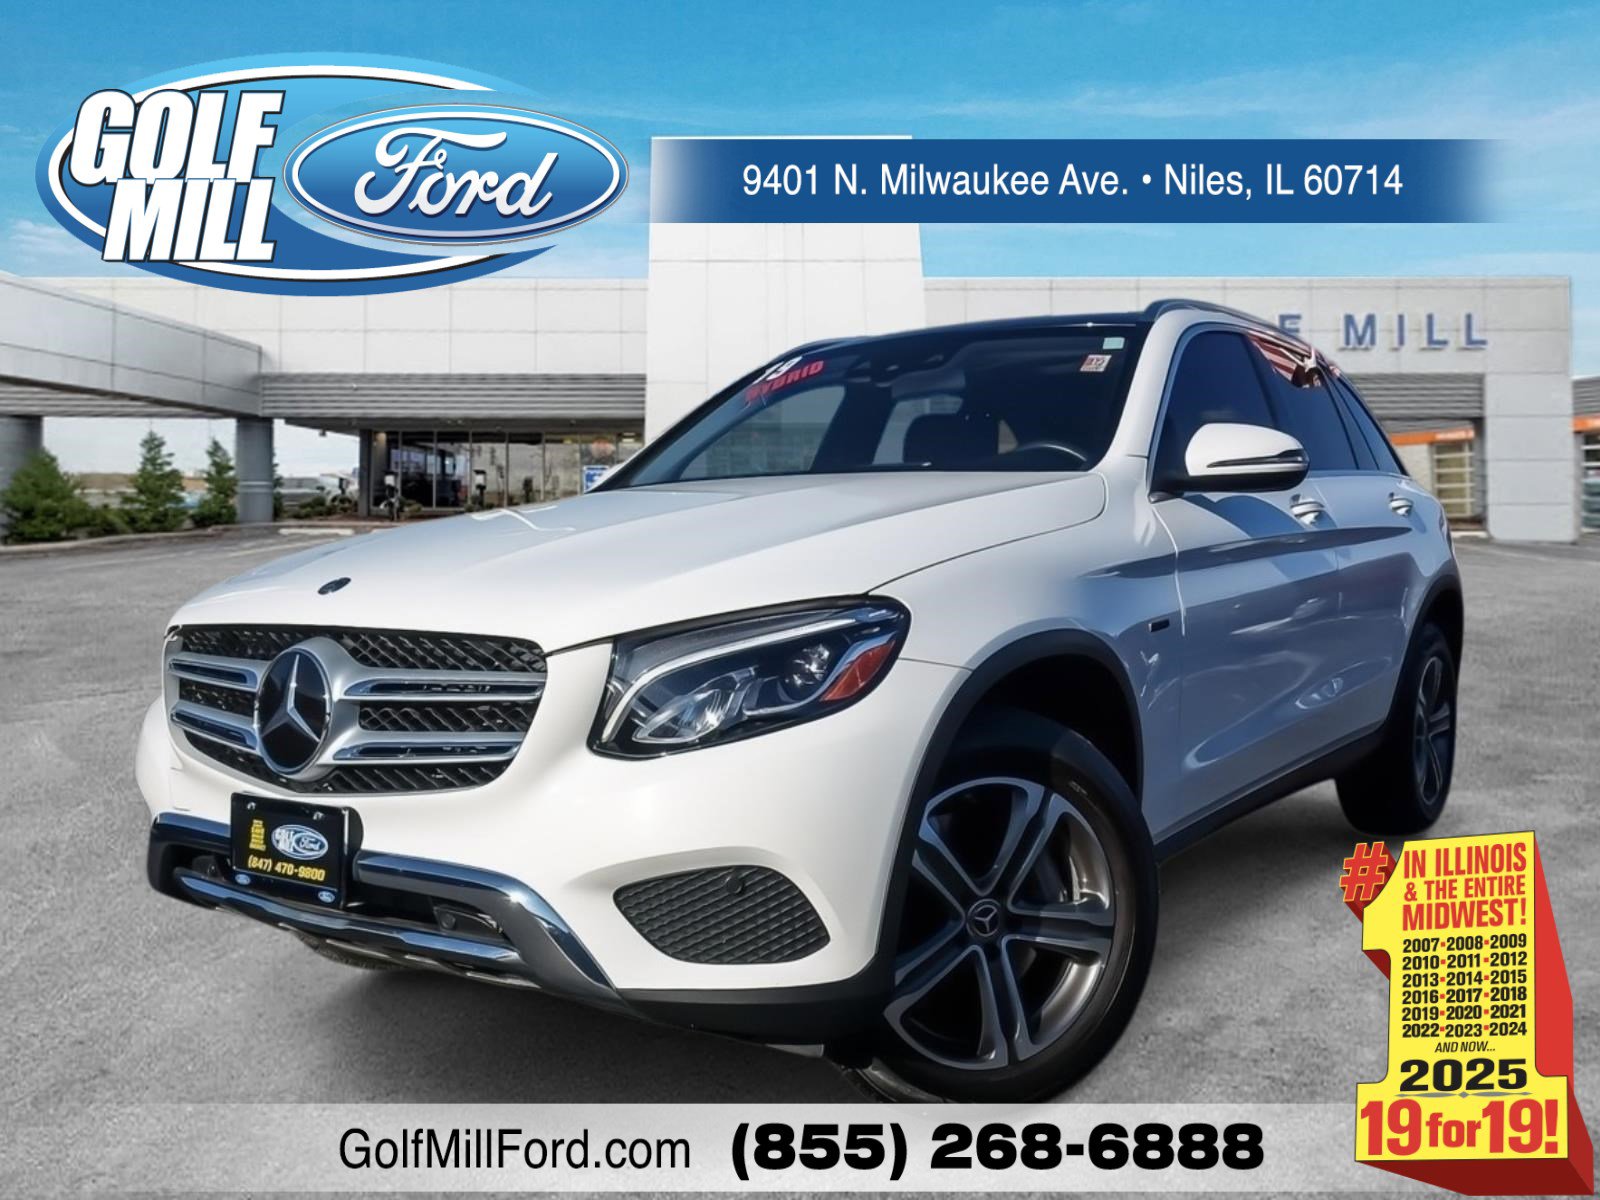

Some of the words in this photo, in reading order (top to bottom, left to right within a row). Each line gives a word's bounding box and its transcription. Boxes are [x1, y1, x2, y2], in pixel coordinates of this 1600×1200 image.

[1343, 313, 1488, 346] MILL
[247, 855, 272, 872] (847)
[274, 862, 326, 881] 470-9800
